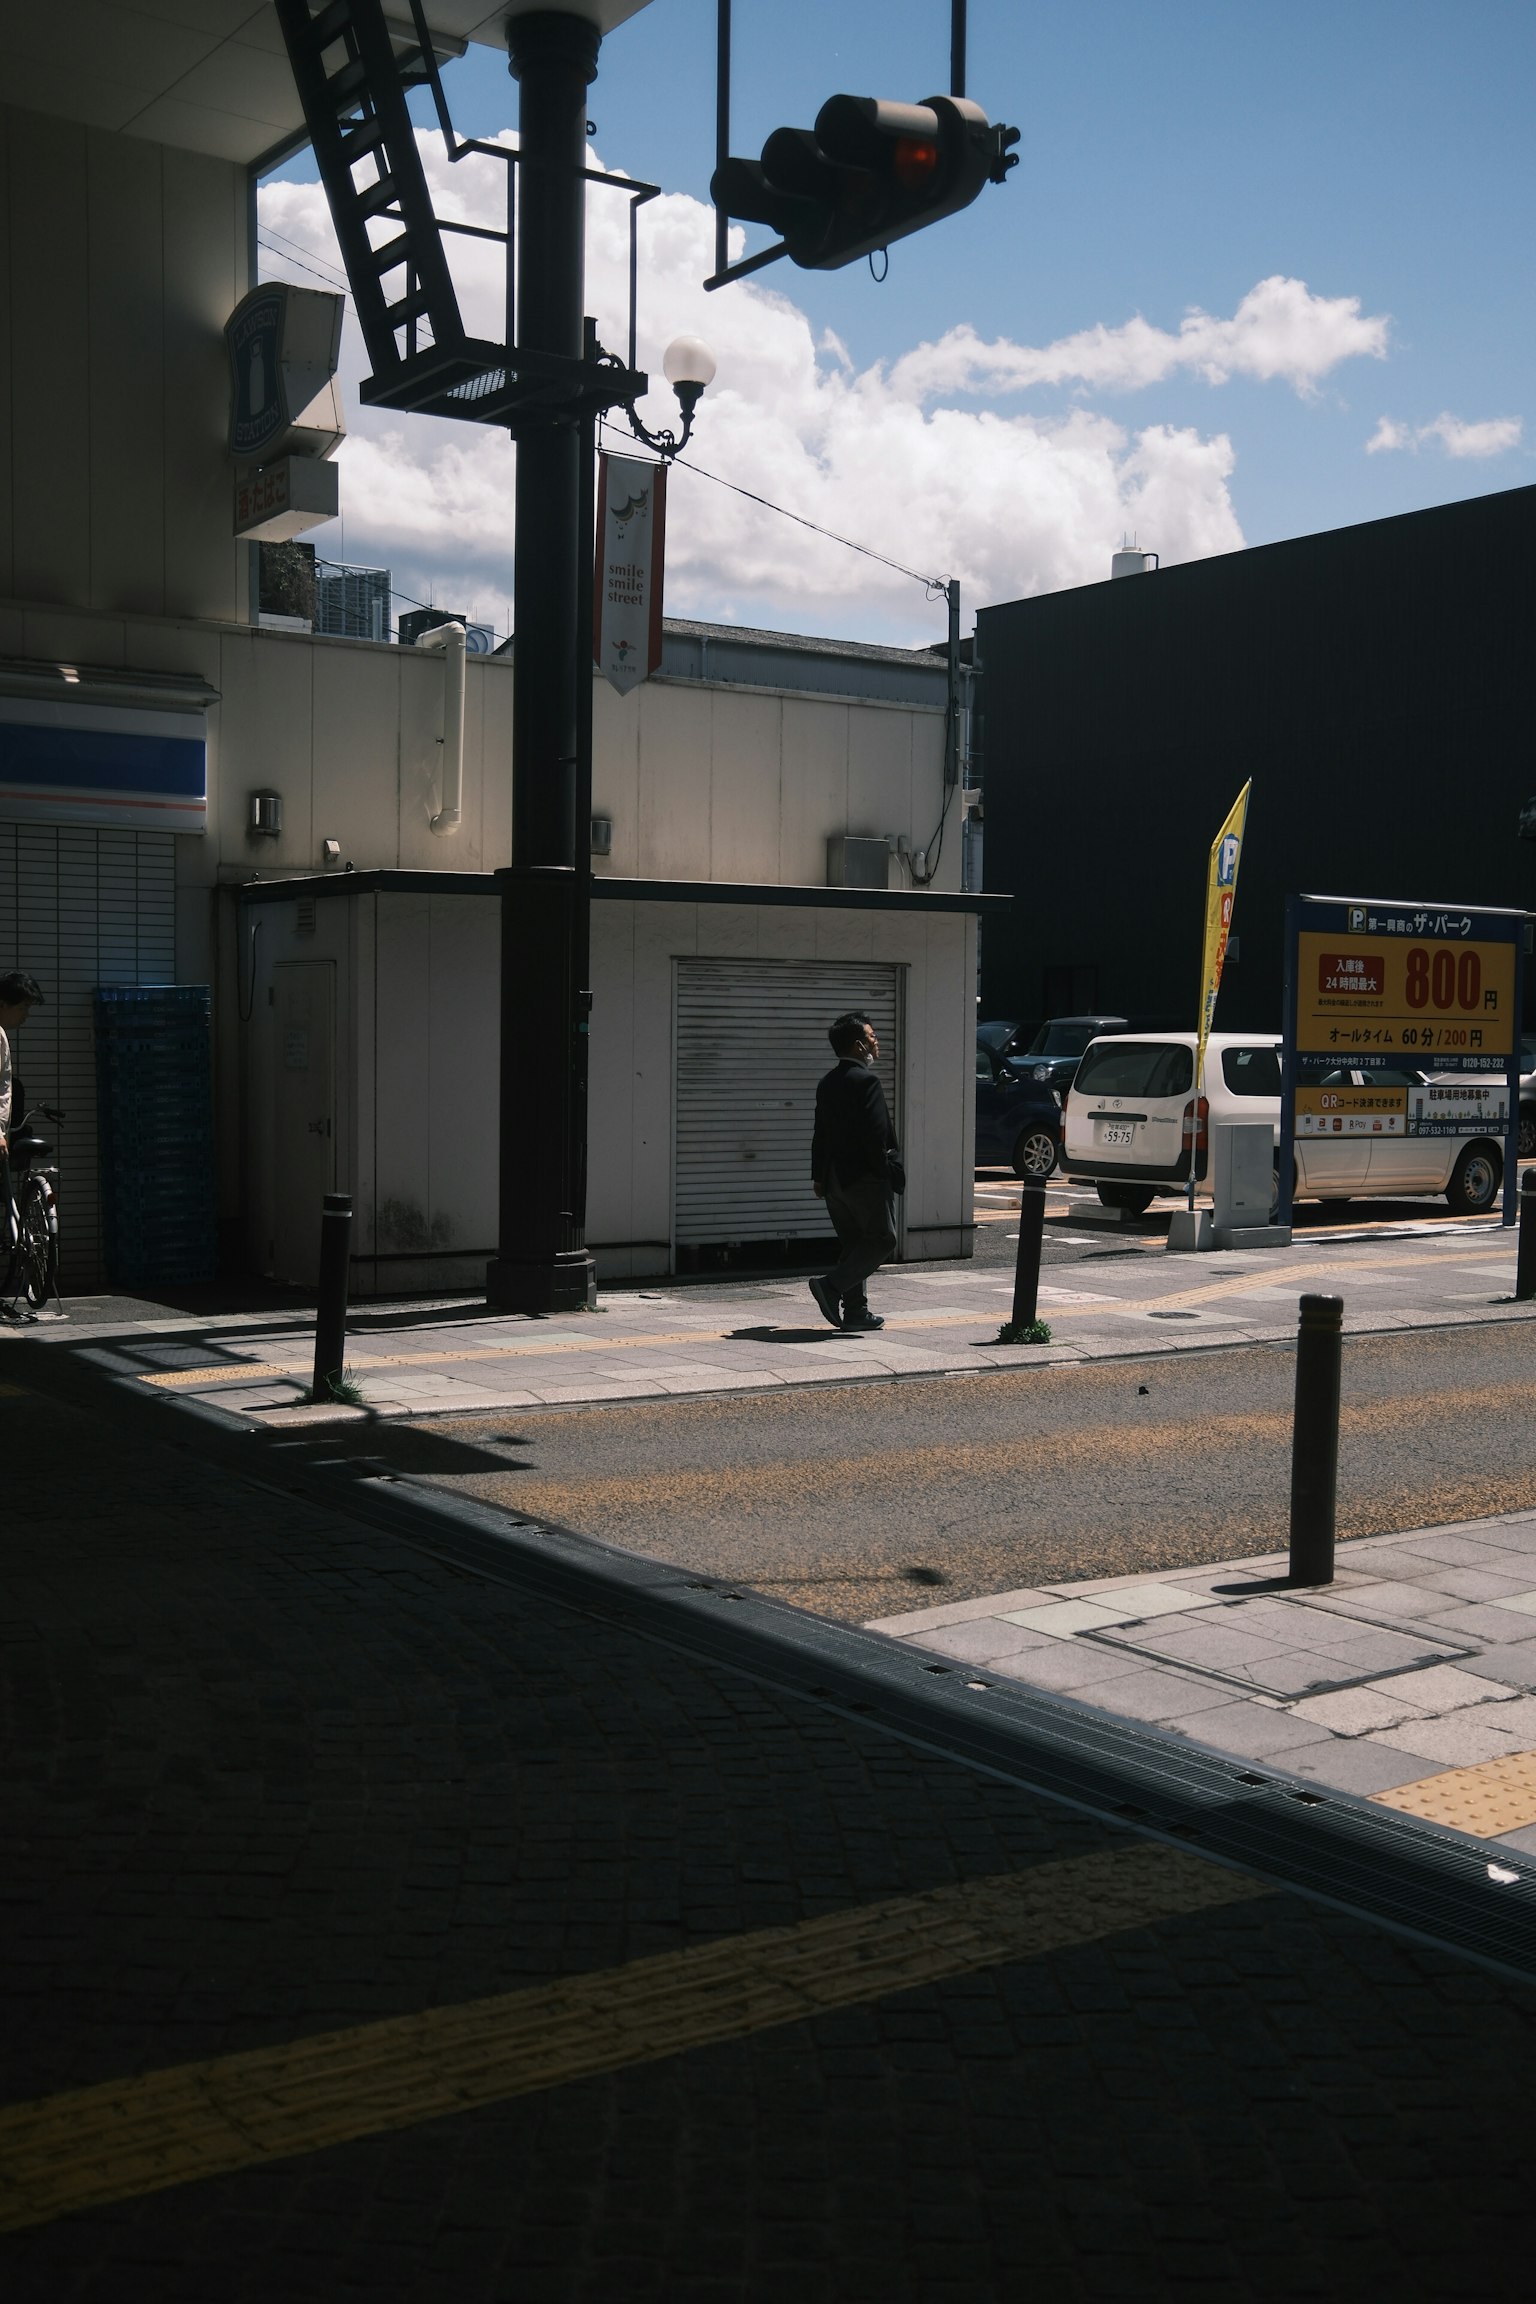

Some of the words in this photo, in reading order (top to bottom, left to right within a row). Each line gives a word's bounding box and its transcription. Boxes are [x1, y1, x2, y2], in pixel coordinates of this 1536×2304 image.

[236, 308, 278, 350] LAWSON
[236, 401, 280, 441] STATION
[609, 564, 644, 579] smile
[608, 578, 644, 593] smile
[607, 592, 644, 606] street
[1336, 959, 1364, 974] 入庫後
[1329, 1027, 1393, 1044] オールタイム
[1320, 1093, 1403, 1110] QRコード決済できます
[1429, 1088, 1490, 1101] 駐車場用地募集中
[1108, 1131, 1130, 1142] 59-75
